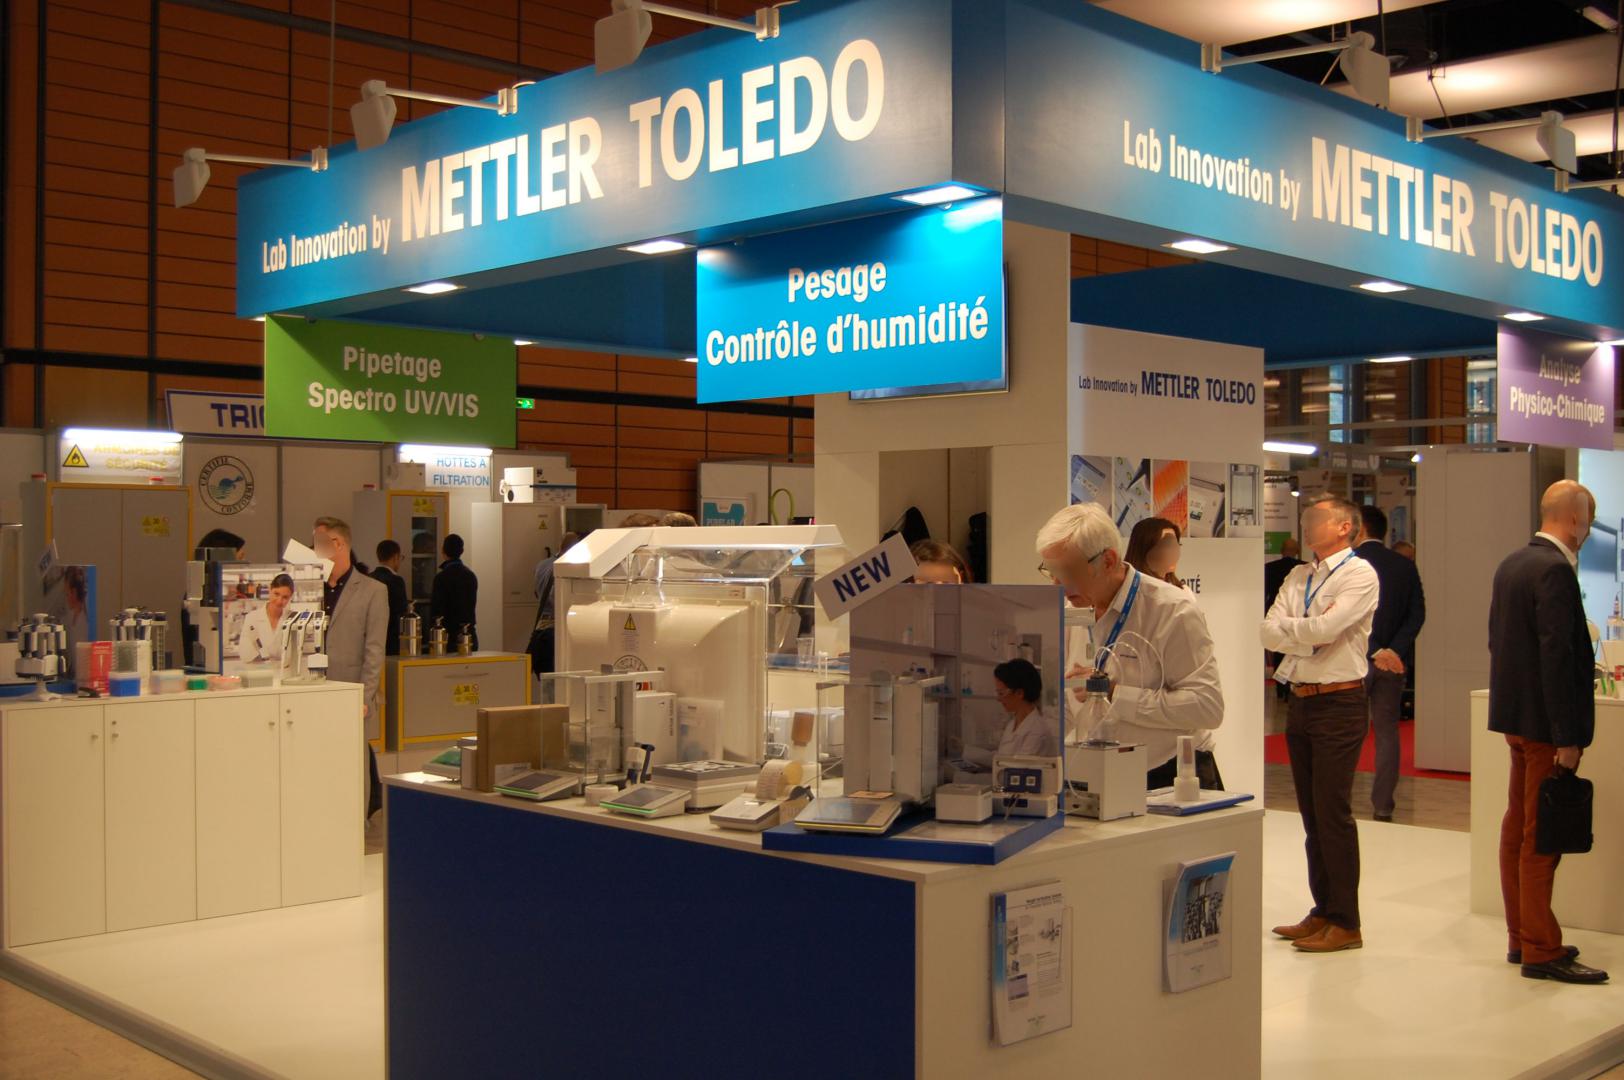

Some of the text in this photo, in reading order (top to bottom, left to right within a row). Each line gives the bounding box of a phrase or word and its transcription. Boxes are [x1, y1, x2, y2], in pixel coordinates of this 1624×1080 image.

[262, 38, 886, 274] Lab Innovation by METTLER TOLEDO
[1123, 119, 1604, 288] Lab Innovation by METTLER TOLEDO
[787, 261, 888, 303] Pesage
[705, 295, 990, 367] Contrôle d'humidité
[343, 345, 443, 383] Pipetage
[1538, 353, 1582, 388] Analyse
[307, 381, 480, 418] Spectro UV/VIS
[1078, 370, 1256, 405] Lab Innovation by METTLER TOLEDO
[1509, 385, 1605, 428] Physico-Chimique
[210, 402, 264, 429] TRI
[433, 473, 490, 487] FILTRATION
[436, 456, 477, 468] HOTTES
[832, 551, 892, 603] NEW
